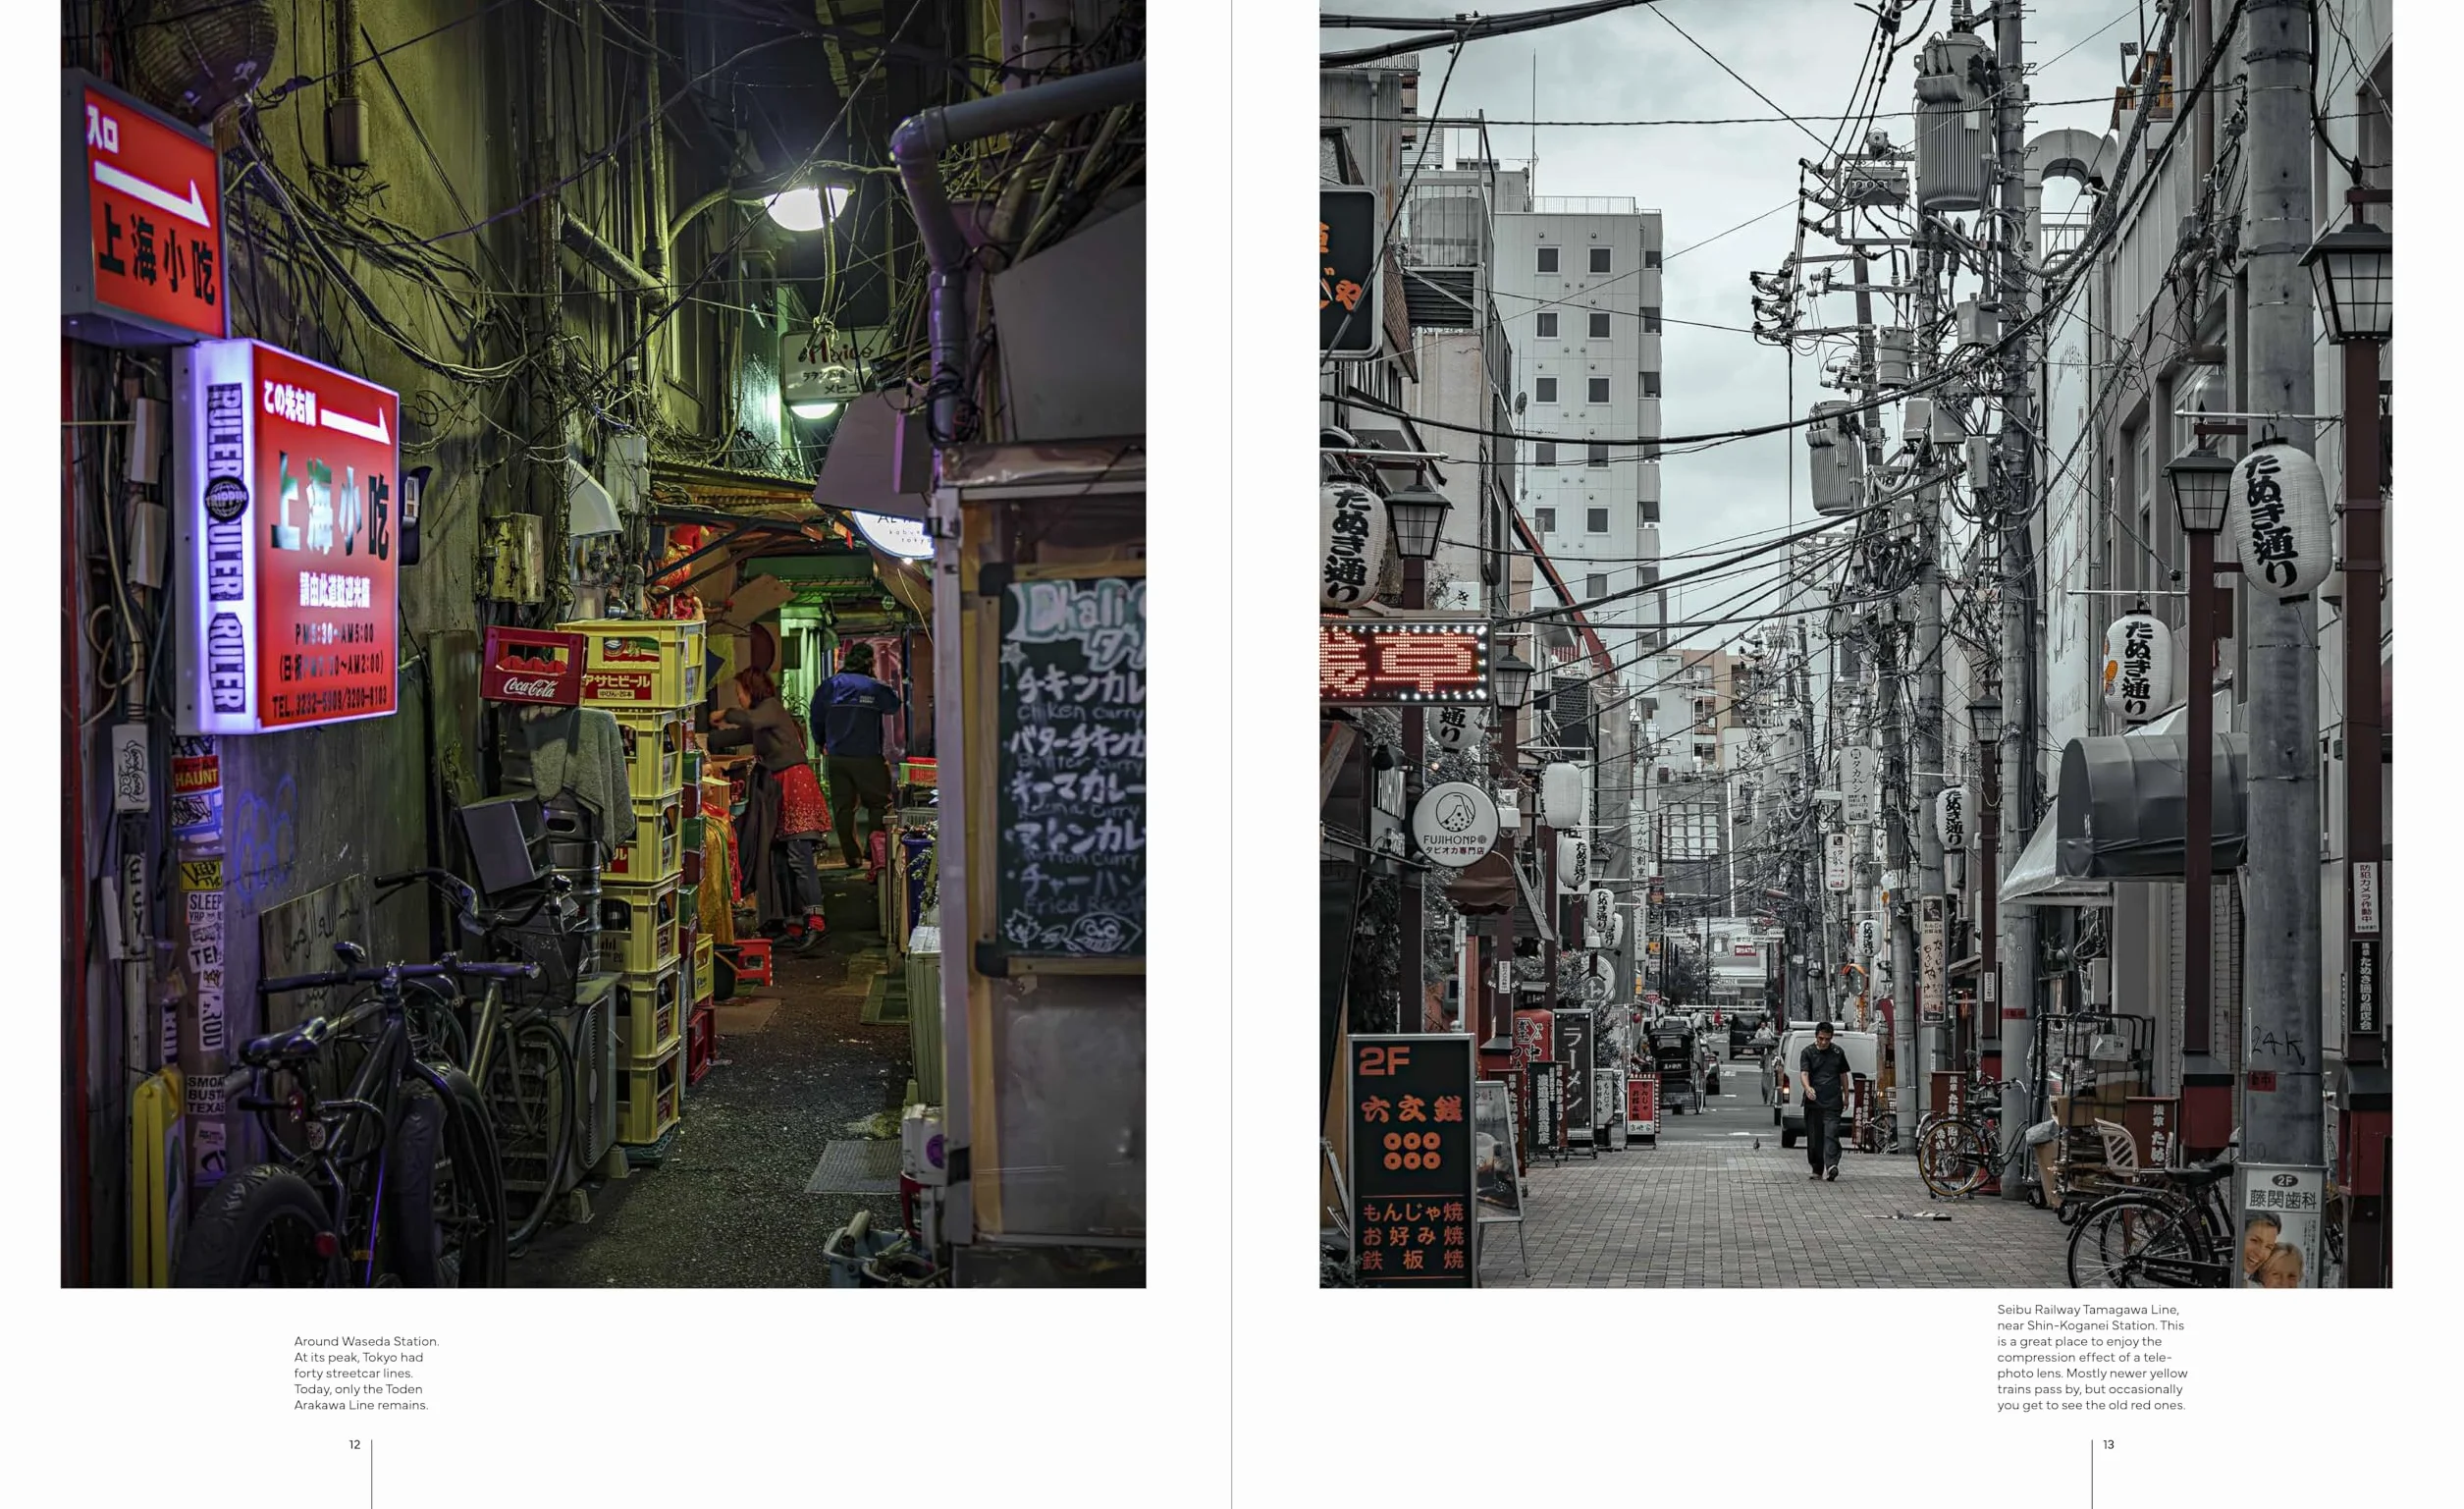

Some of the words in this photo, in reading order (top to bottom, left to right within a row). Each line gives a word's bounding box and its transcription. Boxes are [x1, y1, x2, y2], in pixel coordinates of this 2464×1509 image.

[86, 105, 119, 154] 入口
[98, 202, 215, 306] 上海小吃
[264, 379, 316, 427] この先右側
[270, 451, 390, 562] 上海小吃
[2243, 454, 2299, 589] たぬき通り
[1323, 489, 1372, 604] たぬき通り
[503, 676, 558, 699] Coca-Cola
[585, 674, 651, 688] アサヒビール
[2121, 620, 2155, 716] たぬき通り
[175, 769, 218, 786] HAUNT
[1014, 817, 1146, 854] マトンカレ
[1945, 788, 1963, 845] たぬき通り
[2360, 864, 2372, 923] 防犯カメラ作動中
[1359, 1047, 1411, 1076] 2F
[1563, 1027, 1582, 1110] ラーメン
[2249, 1189, 2318, 1210] 藤関歯科
[2277, 1177, 2294, 1187] 2F
[1363, 1202, 1465, 1222] もんじゃ焼
[1363, 1226, 1465, 1247] お好み焼
[1363, 1249, 1465, 1270] 鉄板焼
